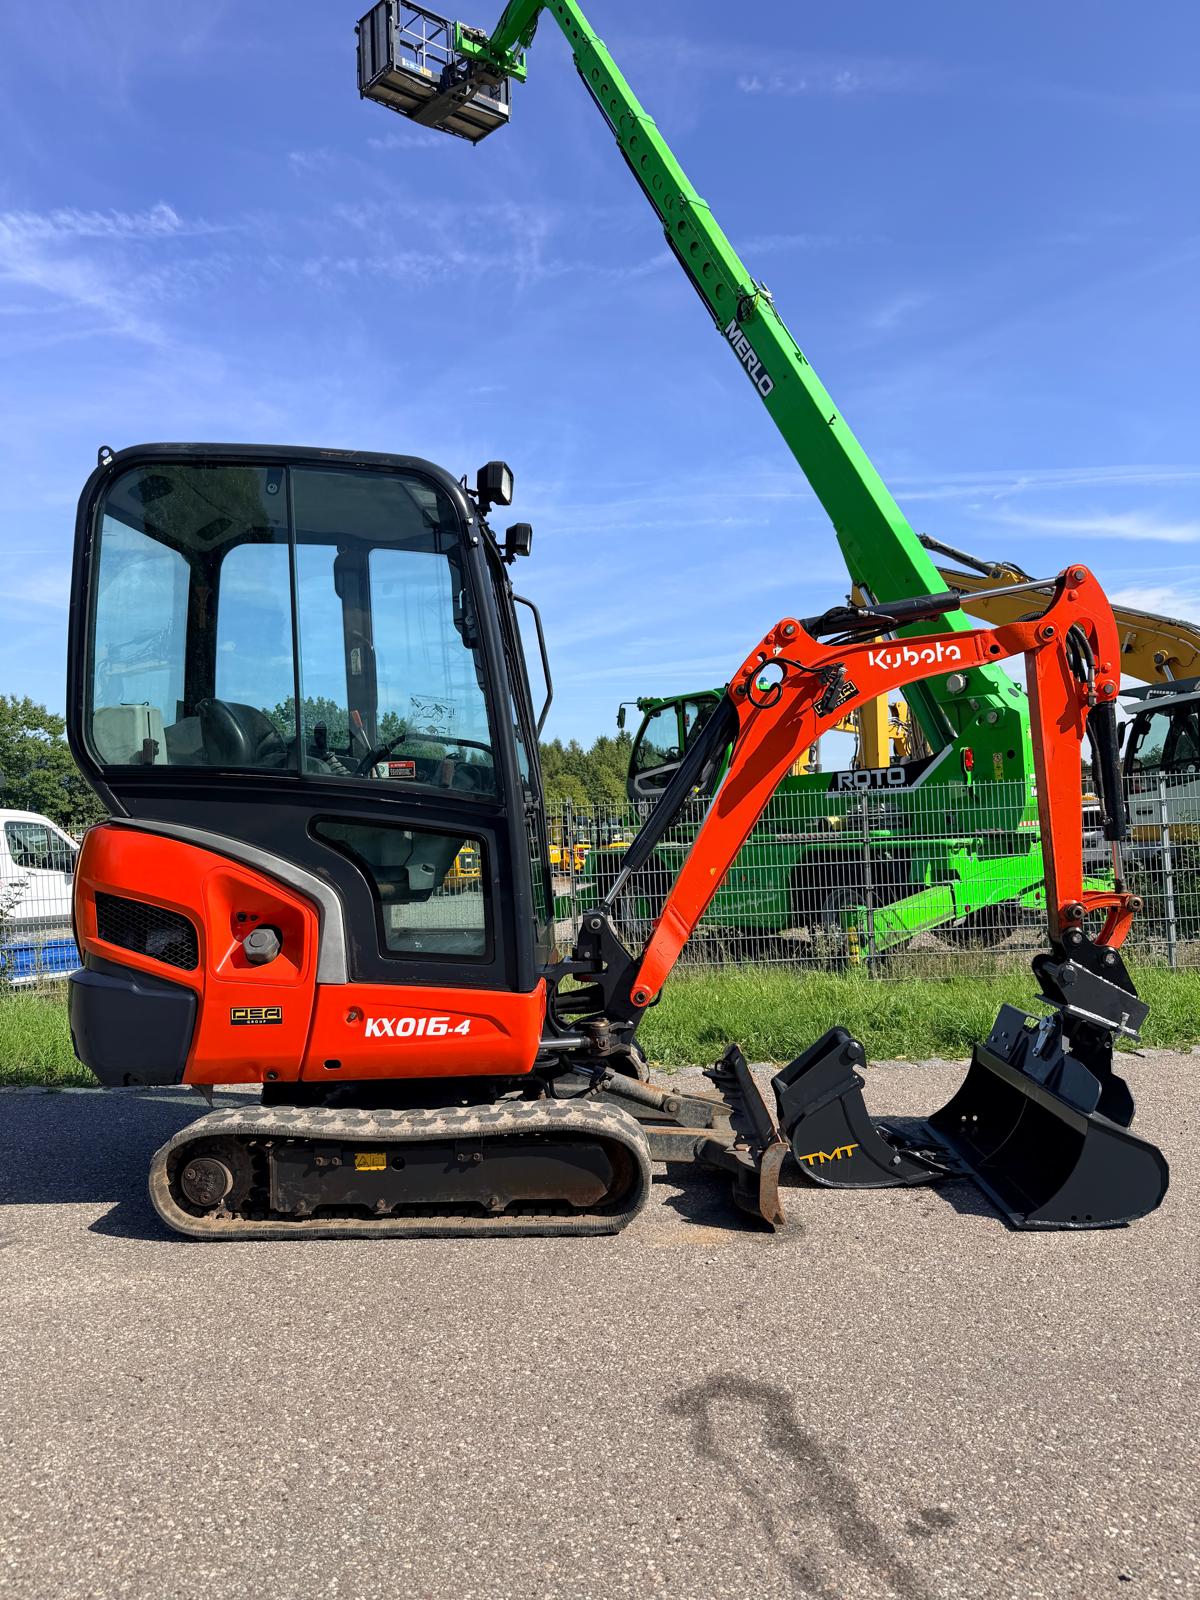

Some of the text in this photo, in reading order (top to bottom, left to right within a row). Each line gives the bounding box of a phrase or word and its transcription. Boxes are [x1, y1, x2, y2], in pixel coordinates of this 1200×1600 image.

[725, 319, 774, 397] MERLO
[868, 642, 961, 670] Kubota
[837, 767, 906, 790] ROTO
[364, 1017, 471, 1037] KX016-4
[799, 1143, 859, 1166] TMT
